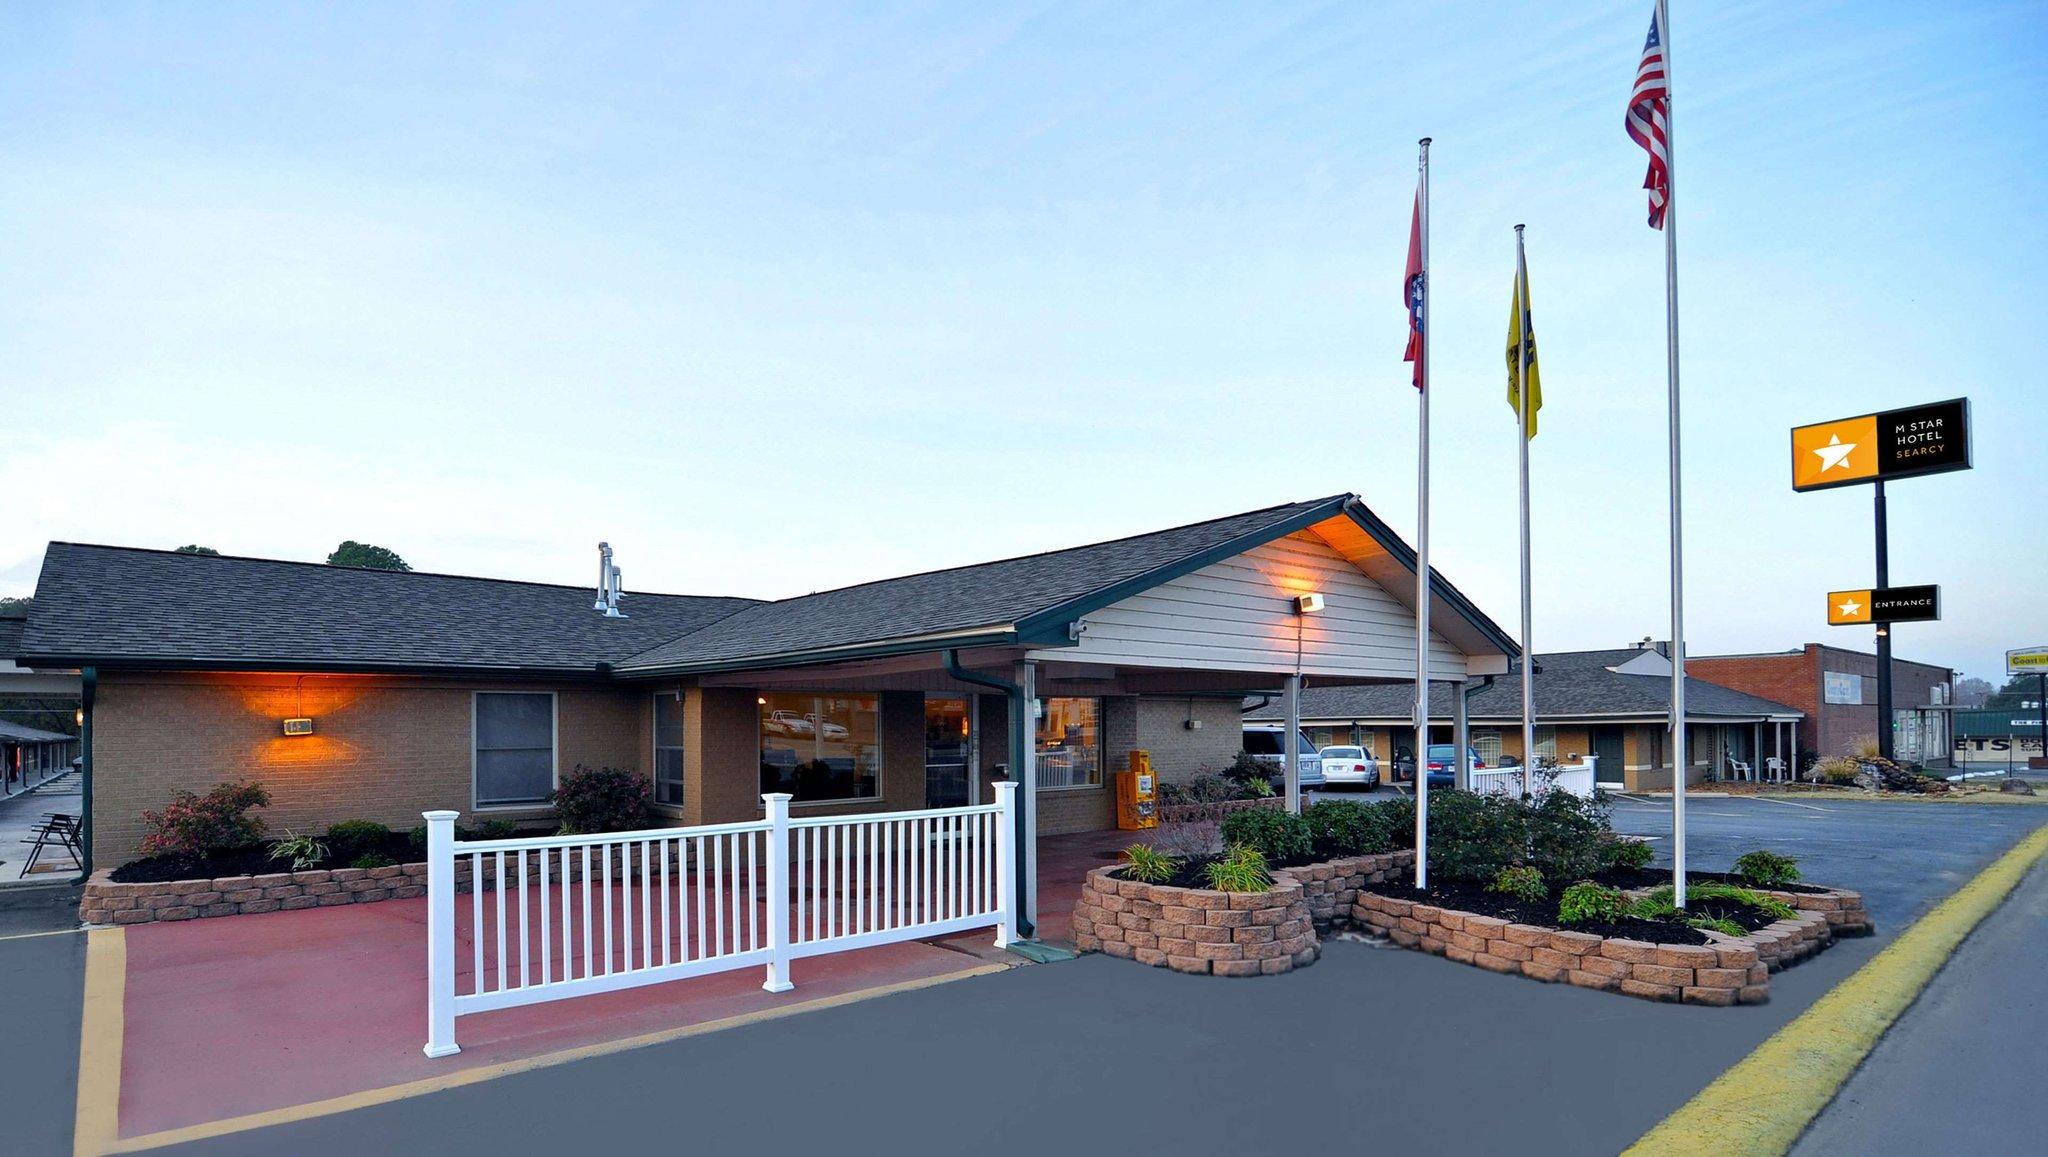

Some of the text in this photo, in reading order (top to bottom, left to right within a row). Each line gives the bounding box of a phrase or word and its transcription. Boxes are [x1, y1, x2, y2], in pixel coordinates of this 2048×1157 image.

[1895, 418, 1943, 434] M STAR
[1897, 431, 1942, 446] HOTEL
[1896, 444, 1945, 459] SEARCY
[1874, 598, 1932, 609] ENTRANCE
